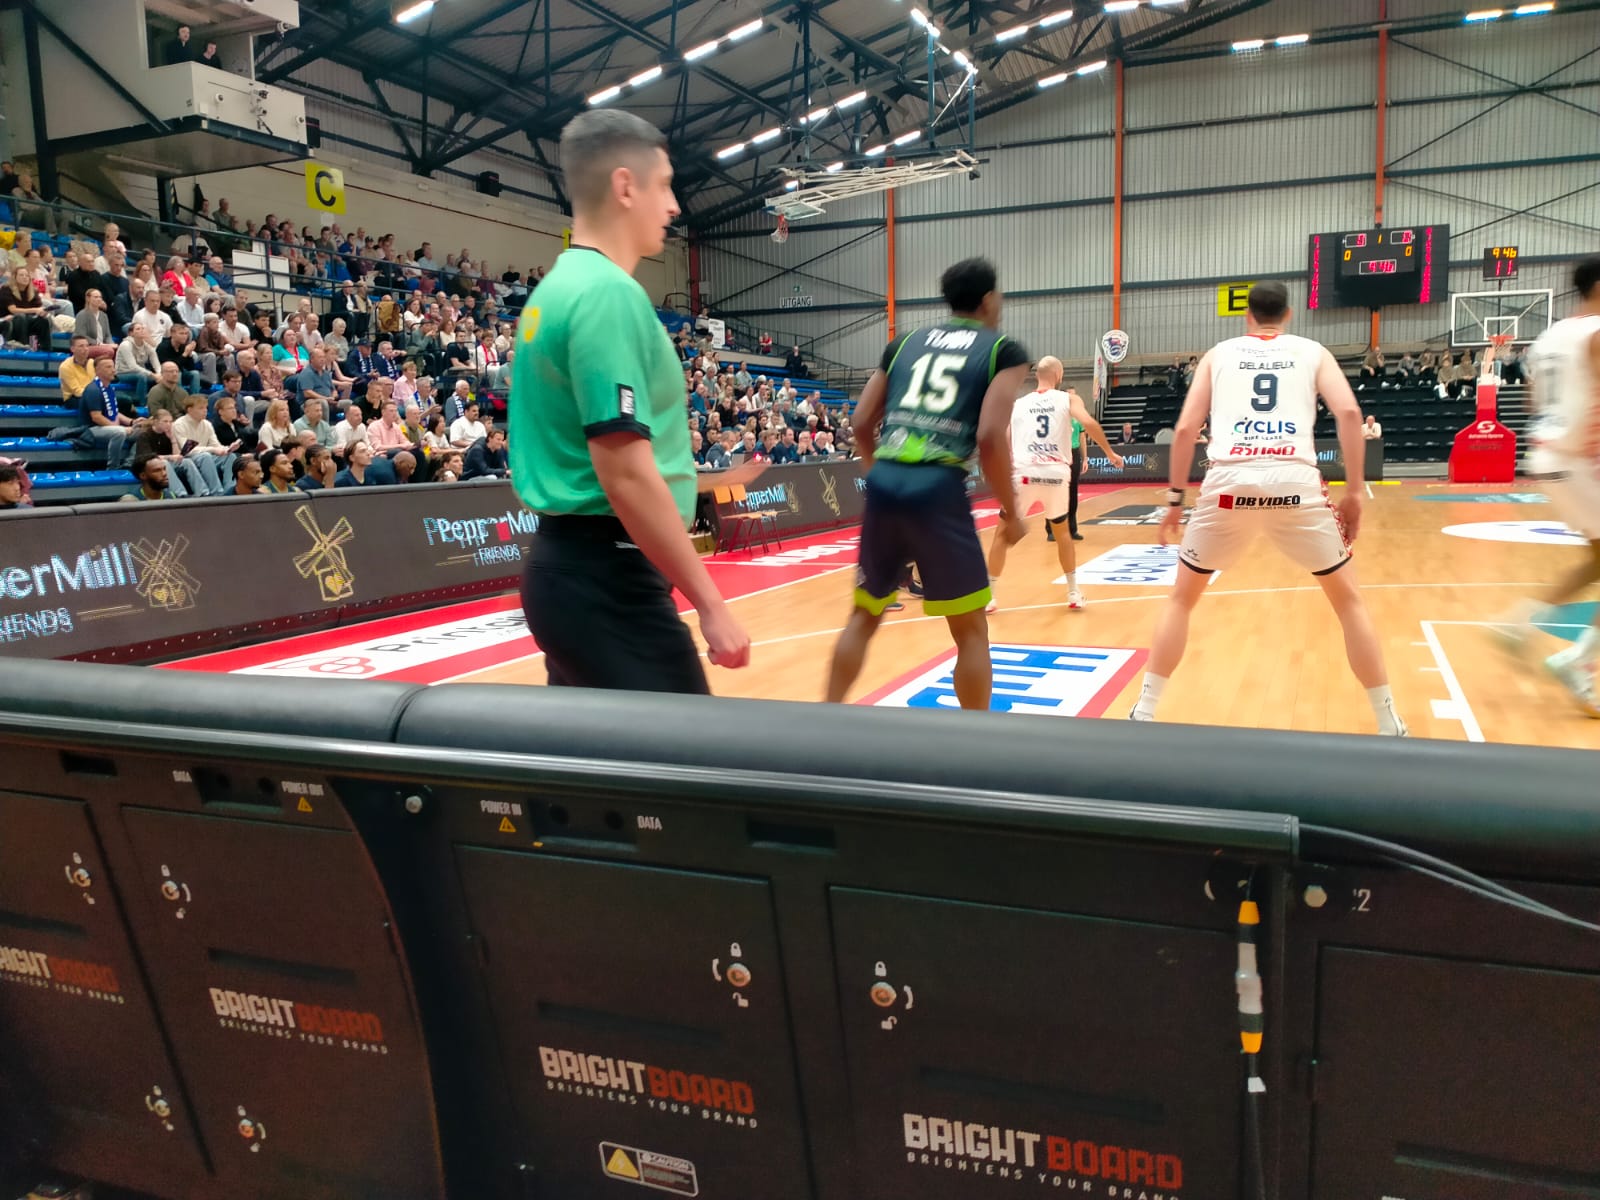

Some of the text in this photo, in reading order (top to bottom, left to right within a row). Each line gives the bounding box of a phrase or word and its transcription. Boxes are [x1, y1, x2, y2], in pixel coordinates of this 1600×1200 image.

[315, 171, 337, 207] C
[1343, 250, 1352, 261] 0
[1405, 246, 1412, 257] 0
[782, 297, 812, 308] UITGANG
[1228, 285, 1248, 311] E
[899, 352, 968, 413] 15
[1250, 373, 1278, 412] 9
[1036, 414, 1050, 438] 3
[1235, 495, 1301, 506] DB VIDEO
[480, 799, 511, 815] POWER
[637, 815, 663, 830] DATA
[1352, 888, 1371, 912] 2
[547, 1080, 758, 1129] BRIGHTENS YOUR BRAND
[906, 1152, 1024, 1181] BRIGHTENS
[1038, 1173, 1093, 1193] YOUR
